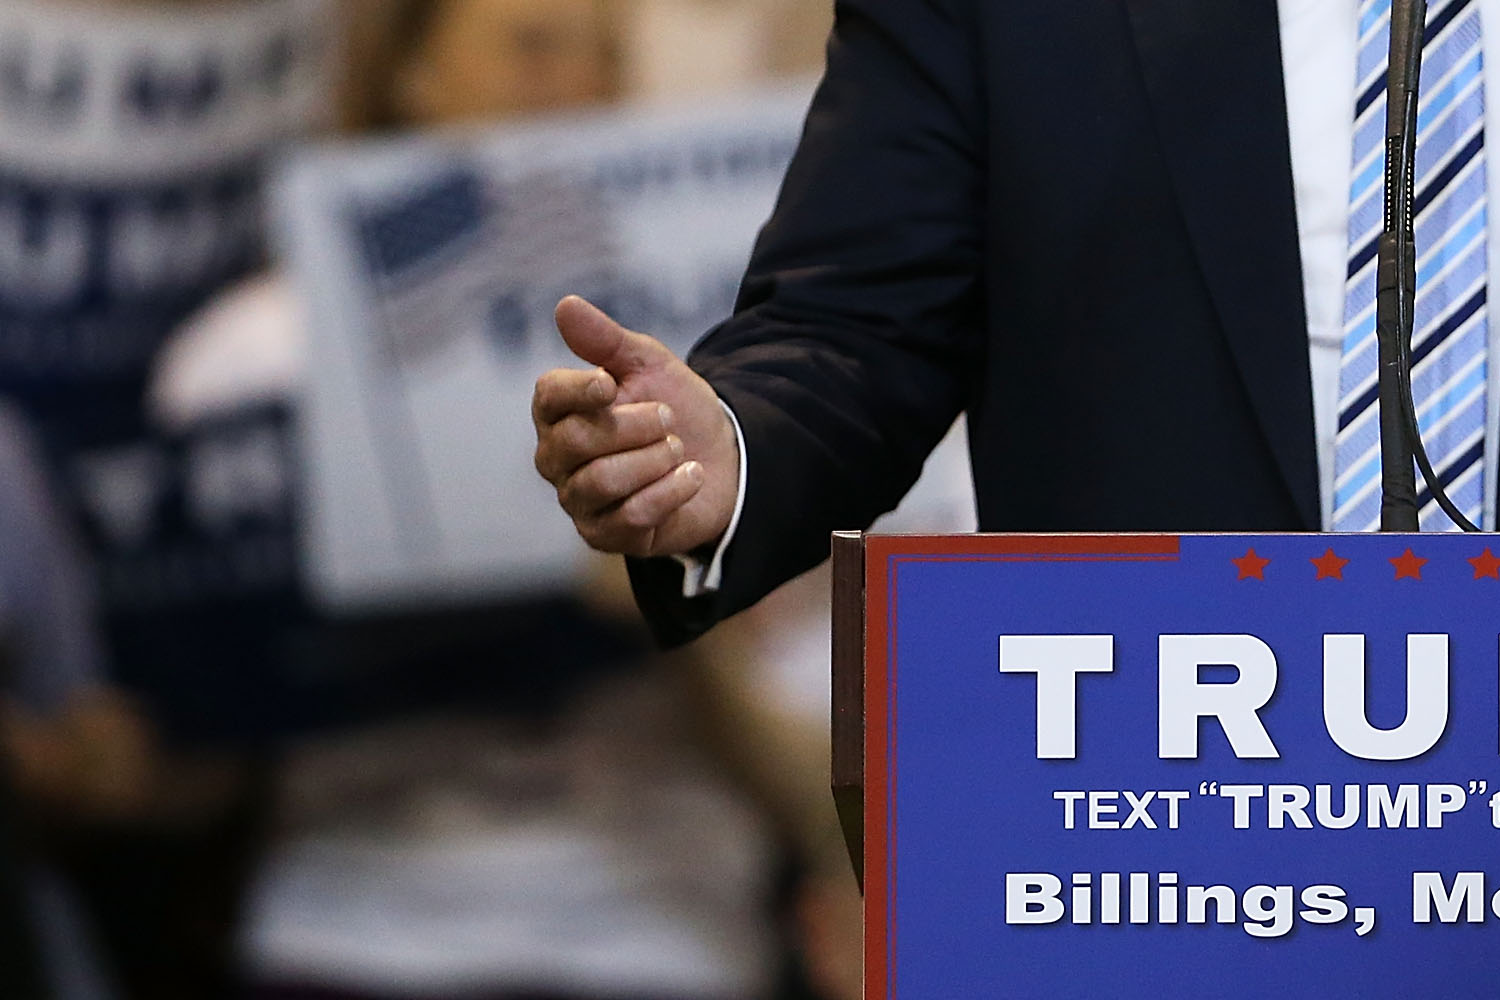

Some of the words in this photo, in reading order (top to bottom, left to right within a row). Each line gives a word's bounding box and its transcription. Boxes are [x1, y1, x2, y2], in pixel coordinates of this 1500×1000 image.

[1053, 791, 1190, 829] TEXT
[1199, 780, 1487, 829] “TRUMP”
[1005, 871, 1375, 937] Billings,
